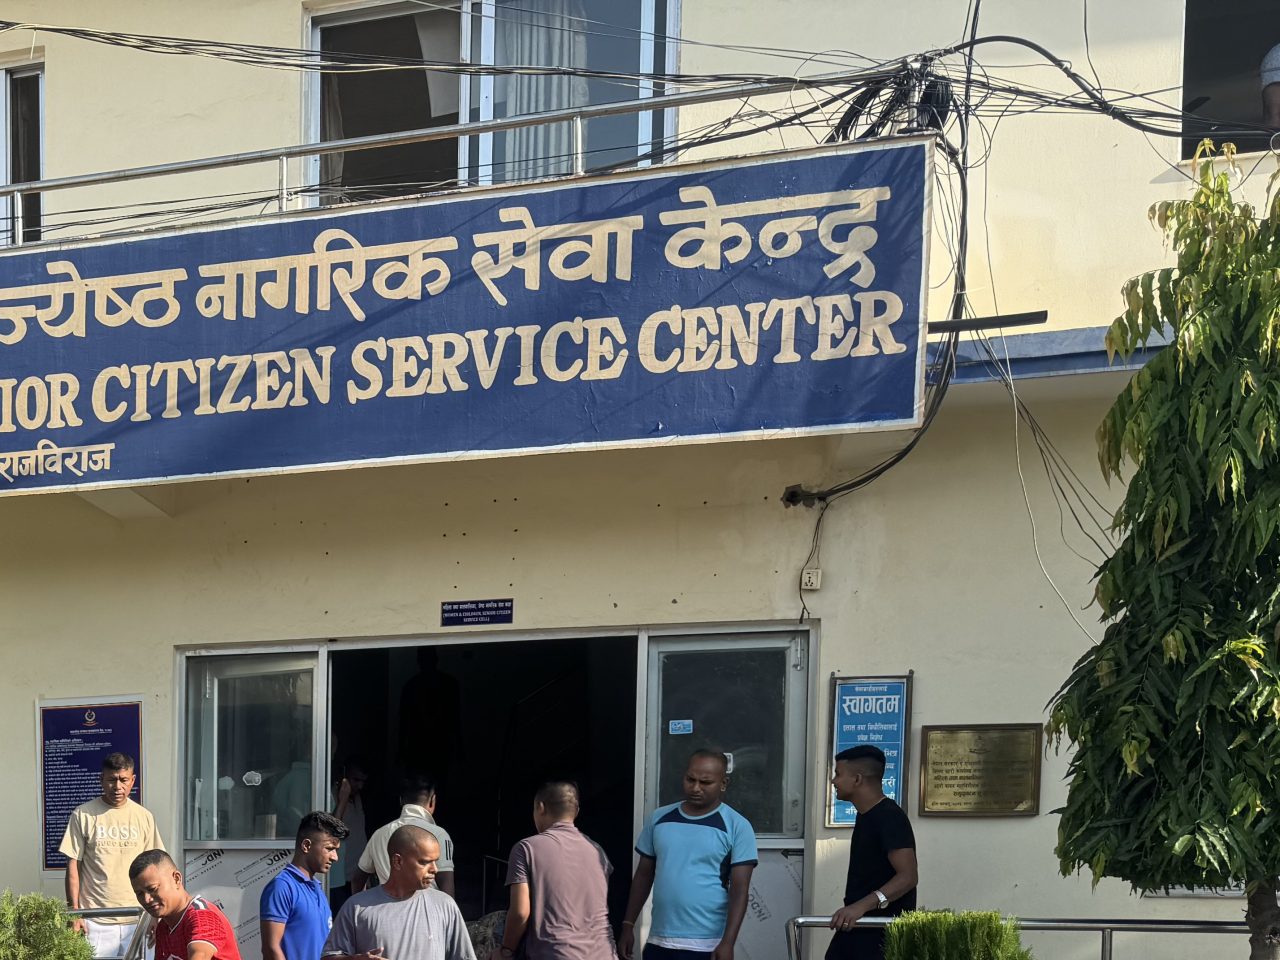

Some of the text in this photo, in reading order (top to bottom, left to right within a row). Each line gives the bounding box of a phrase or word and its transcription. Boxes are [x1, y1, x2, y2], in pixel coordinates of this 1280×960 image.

[196, 229, 458, 321] नागरिक
[472, 207, 643, 305] सेवा
[658, 186, 891, 288] केन्द्र
[91, 346, 336, 422] CITIZEN
[346, 316, 629, 404] SERVICE
[637, 290, 907, 373] CENTER
[842, 695, 900, 716] स्वागतम
[96, 825, 138, 840] BOSS
